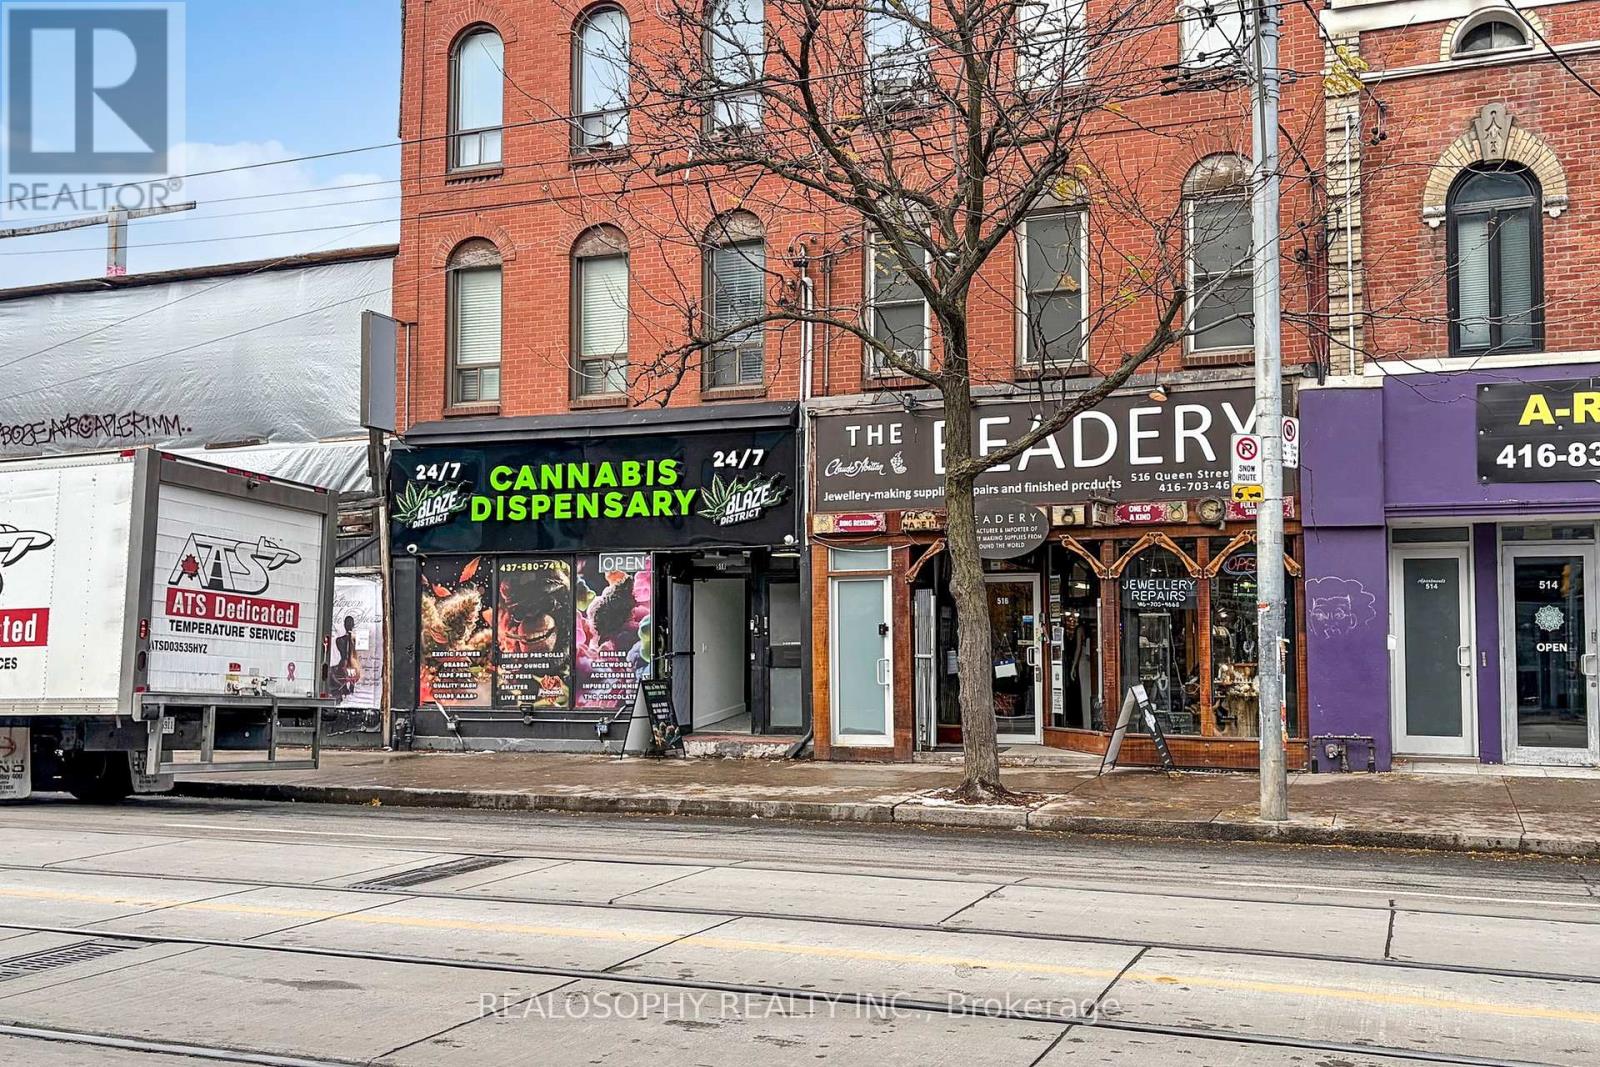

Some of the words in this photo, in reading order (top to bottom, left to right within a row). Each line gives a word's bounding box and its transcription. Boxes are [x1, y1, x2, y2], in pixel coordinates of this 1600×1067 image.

[845, 423, 903, 447] THE
[713, 448, 764, 468] 24/7
[1496, 442, 1600, 468] 416-83
[416, 461, 461, 481] 24/7
[489, 458, 678, 491] CANNABIS
[1131, 473, 1150, 482] 516
[1154, 470, 1193, 482] Queen
[1197, 469, 1231, 480] Stree
[1237, 473, 1257, 481] ROUTE
[823, 488, 911, 502] Jewellery-making
[913, 486, 945, 501] suppli
[973, 484, 999, 497] pairs
[1001, 482, 1023, 494] and
[1024, 480, 1070, 493] finished
[1159, 481, 1230, 493] 416-703-46
[417, 491, 458, 519] BLAZE
[471, 488, 698, 521] DISPENSARY
[725, 483, 771, 515] BLAZE
[1240, 501, 1255, 509] FULL
[412, 512, 450, 528] DISTRICT
[720, 507, 762, 525] DISTRICT
[974, 512, 1038, 525] ADERY
[1135, 512, 1151, 520] KIND
[976, 528, 999, 536] ACTURER
[1004, 527, 1029, 535] IMPORTER
[983, 534, 1004, 542] MAKING
[1004, 533, 1027, 541] SUPPLIES
[168, 533, 268, 595] ATS
[602, 557, 646, 571] OPEN
[1226, 556, 1257, 571] OPE
[1122, 579, 1196, 591] JEWELLERY
[1539, 580, 1558, 589] 514
[997, 597, 1009, 605] 516
[1131, 590, 1186, 602] REPAIRS
[172, 592, 207, 617] ATS
[215, 597, 294, 625] Dedicated
[0, 613, 38, 643] ted
[169, 620, 245, 640] TEMPERATURE
[249, 627, 296, 645] SERVICES
[1536, 642, 1568, 652] OPEN
